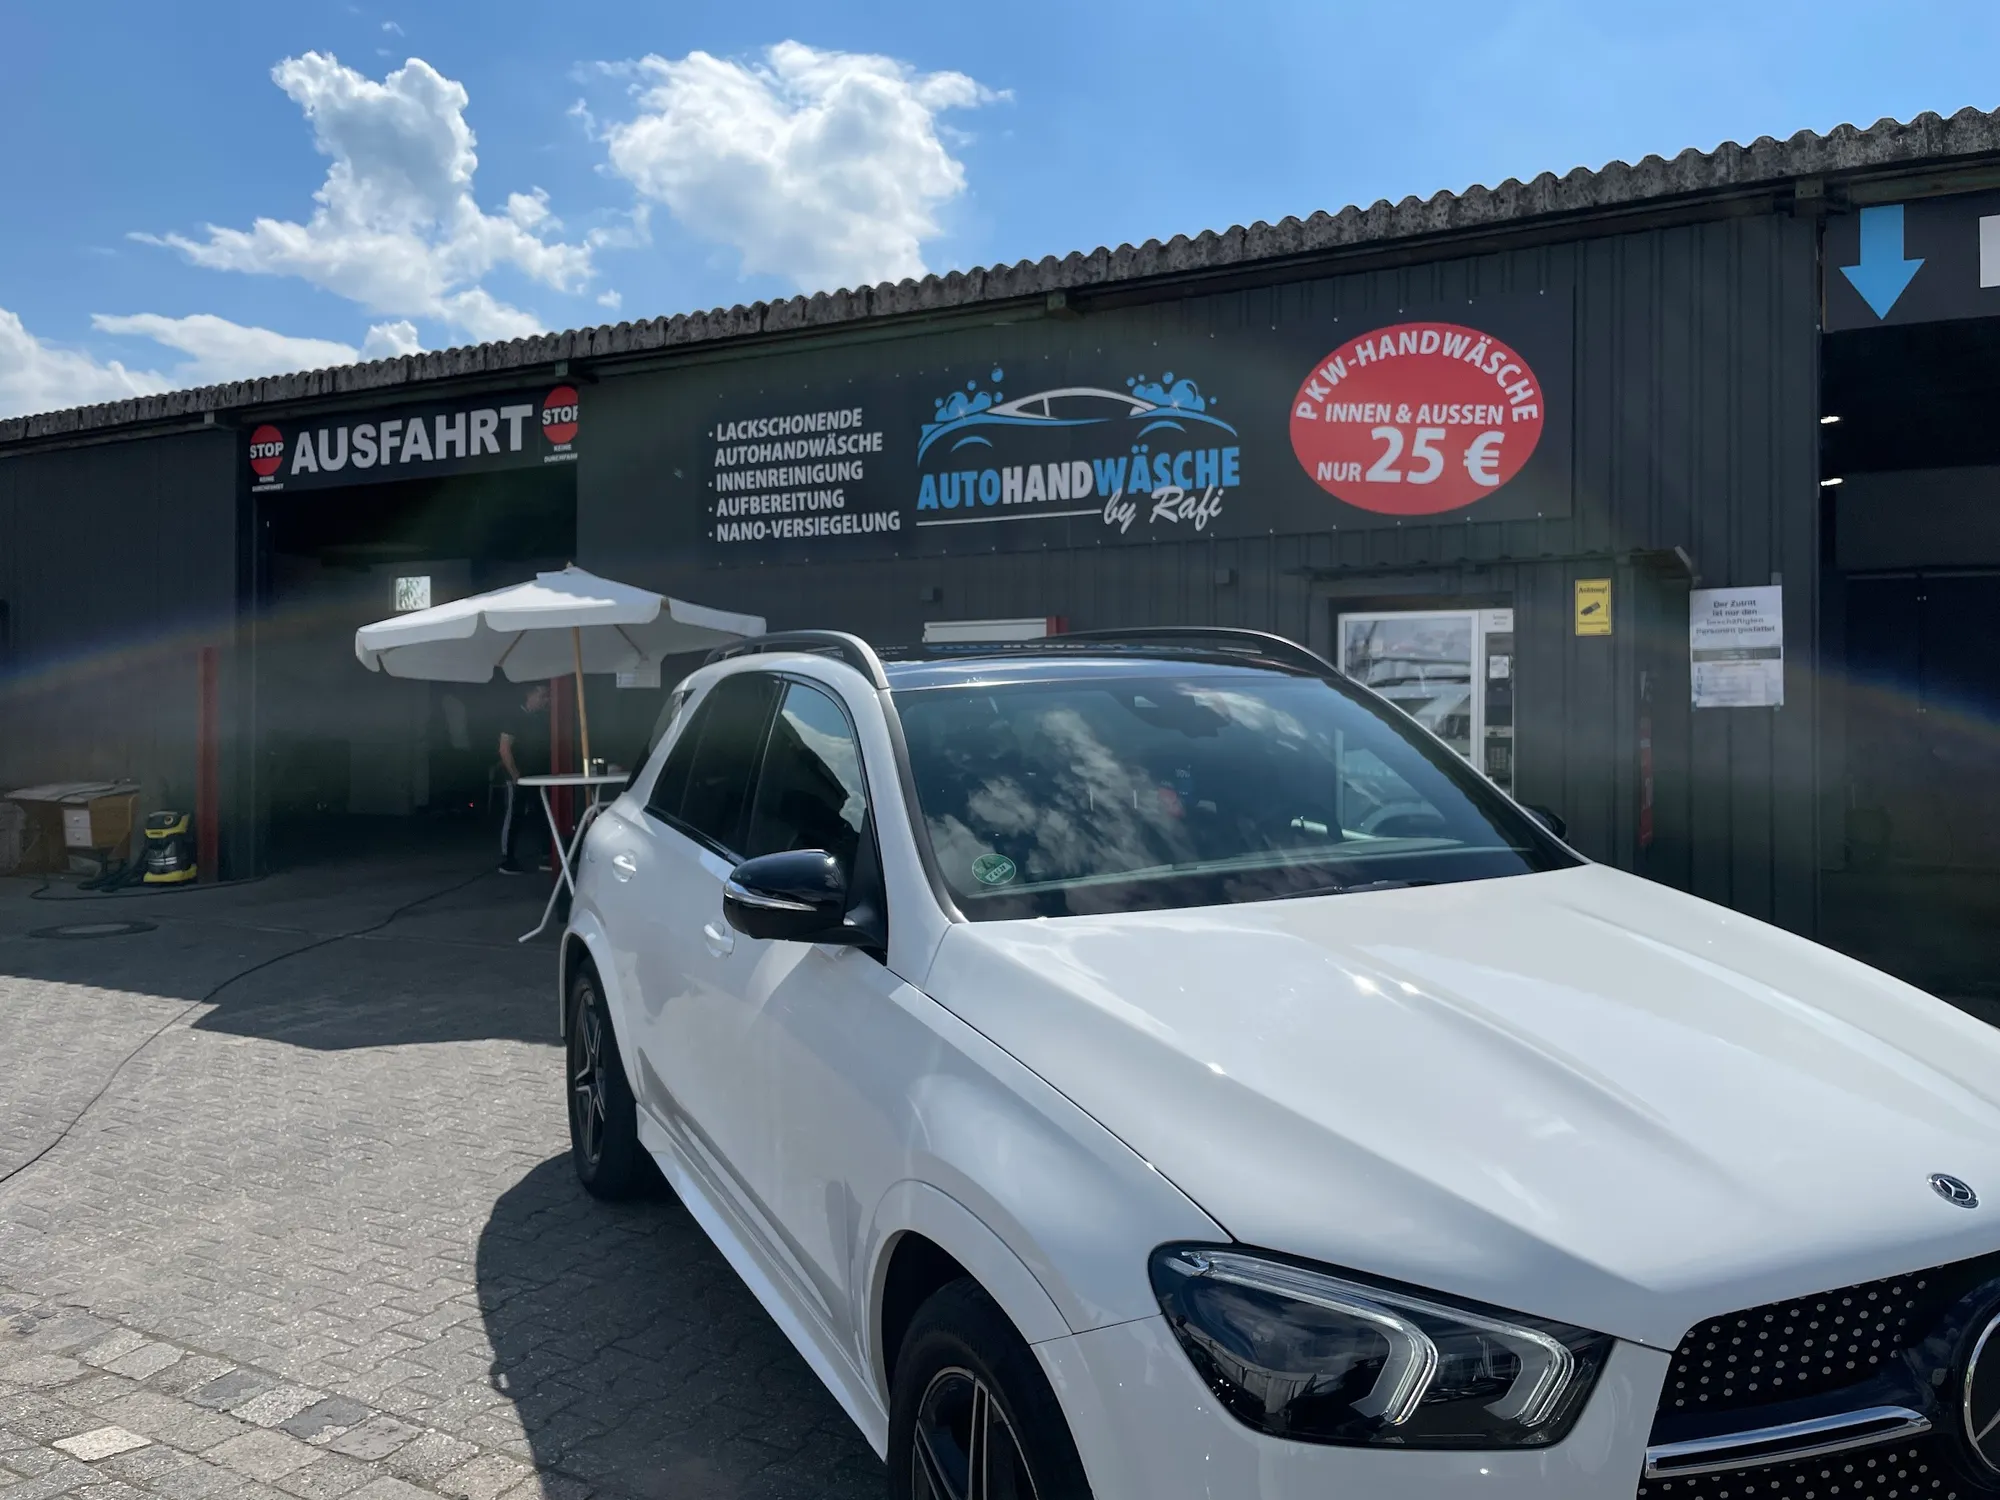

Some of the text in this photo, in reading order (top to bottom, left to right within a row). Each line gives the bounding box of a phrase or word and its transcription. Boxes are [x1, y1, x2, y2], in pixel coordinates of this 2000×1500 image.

[1296, 330, 1538, 423] PKW-HANDWÄSCHE
[716, 408, 863, 442] LACKSCHONENDE
[1325, 403, 1504, 425] INNEN & AUSSEN
[249, 441, 284, 459] STOP
[291, 403, 533, 476] AUSFAHRT
[714, 432, 884, 467] AUTOHANDWÄSCHE
[1317, 426, 1505, 486] NUR 25 €
[716, 460, 864, 492] INNENREINIGUNG
[917, 444, 1240, 511] AUTOHANDWÄSCHE
[716, 489, 845, 517] AUFBEREITUNG
[1103, 483, 1224, 534] by Rafi
[716, 511, 901, 542] NANO-VERSIEGELUNG
[1713, 600, 1728, 608] Der
